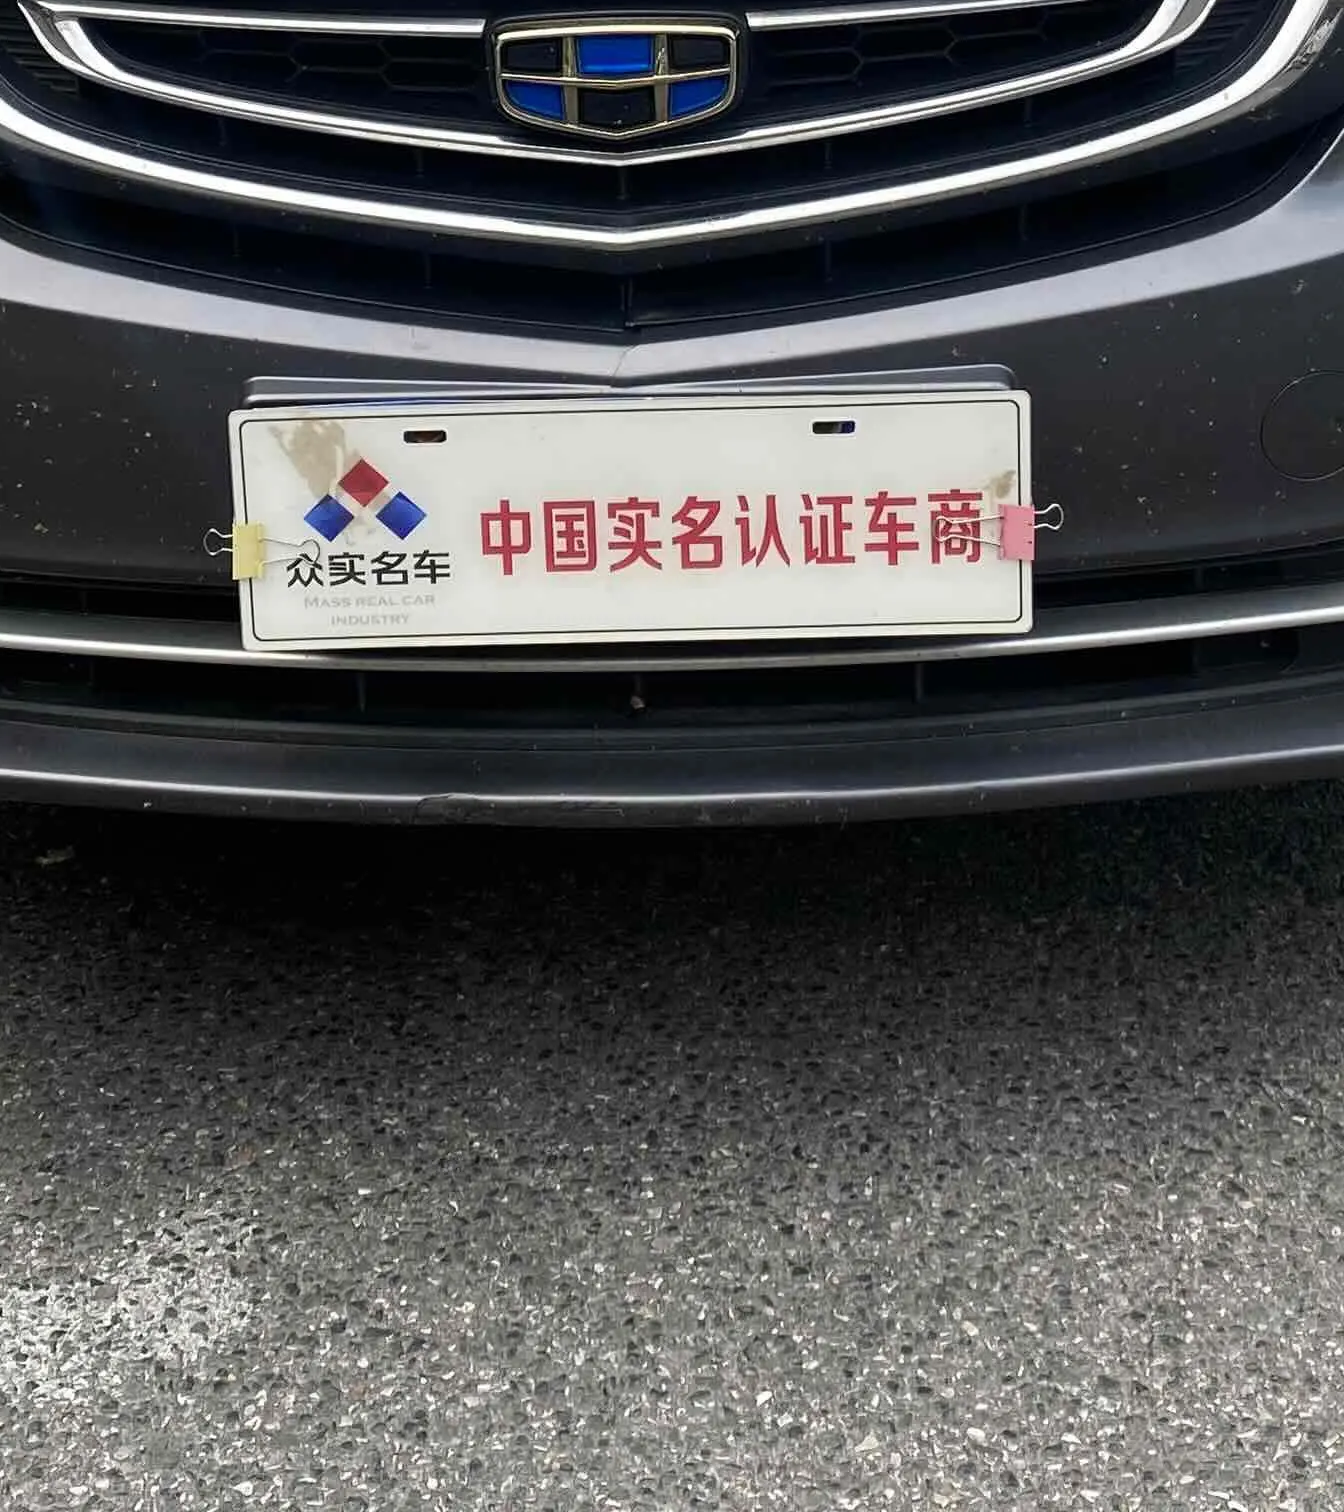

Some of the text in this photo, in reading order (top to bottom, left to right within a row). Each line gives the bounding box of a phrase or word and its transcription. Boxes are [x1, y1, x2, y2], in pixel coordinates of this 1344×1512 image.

[479, 489, 984, 576] 中国实名认证车商
[286, 549, 451, 588] 众实名车
[304, 594, 435, 609] MASS REAL CAR
[331, 614, 409, 626] INDUSTRY
